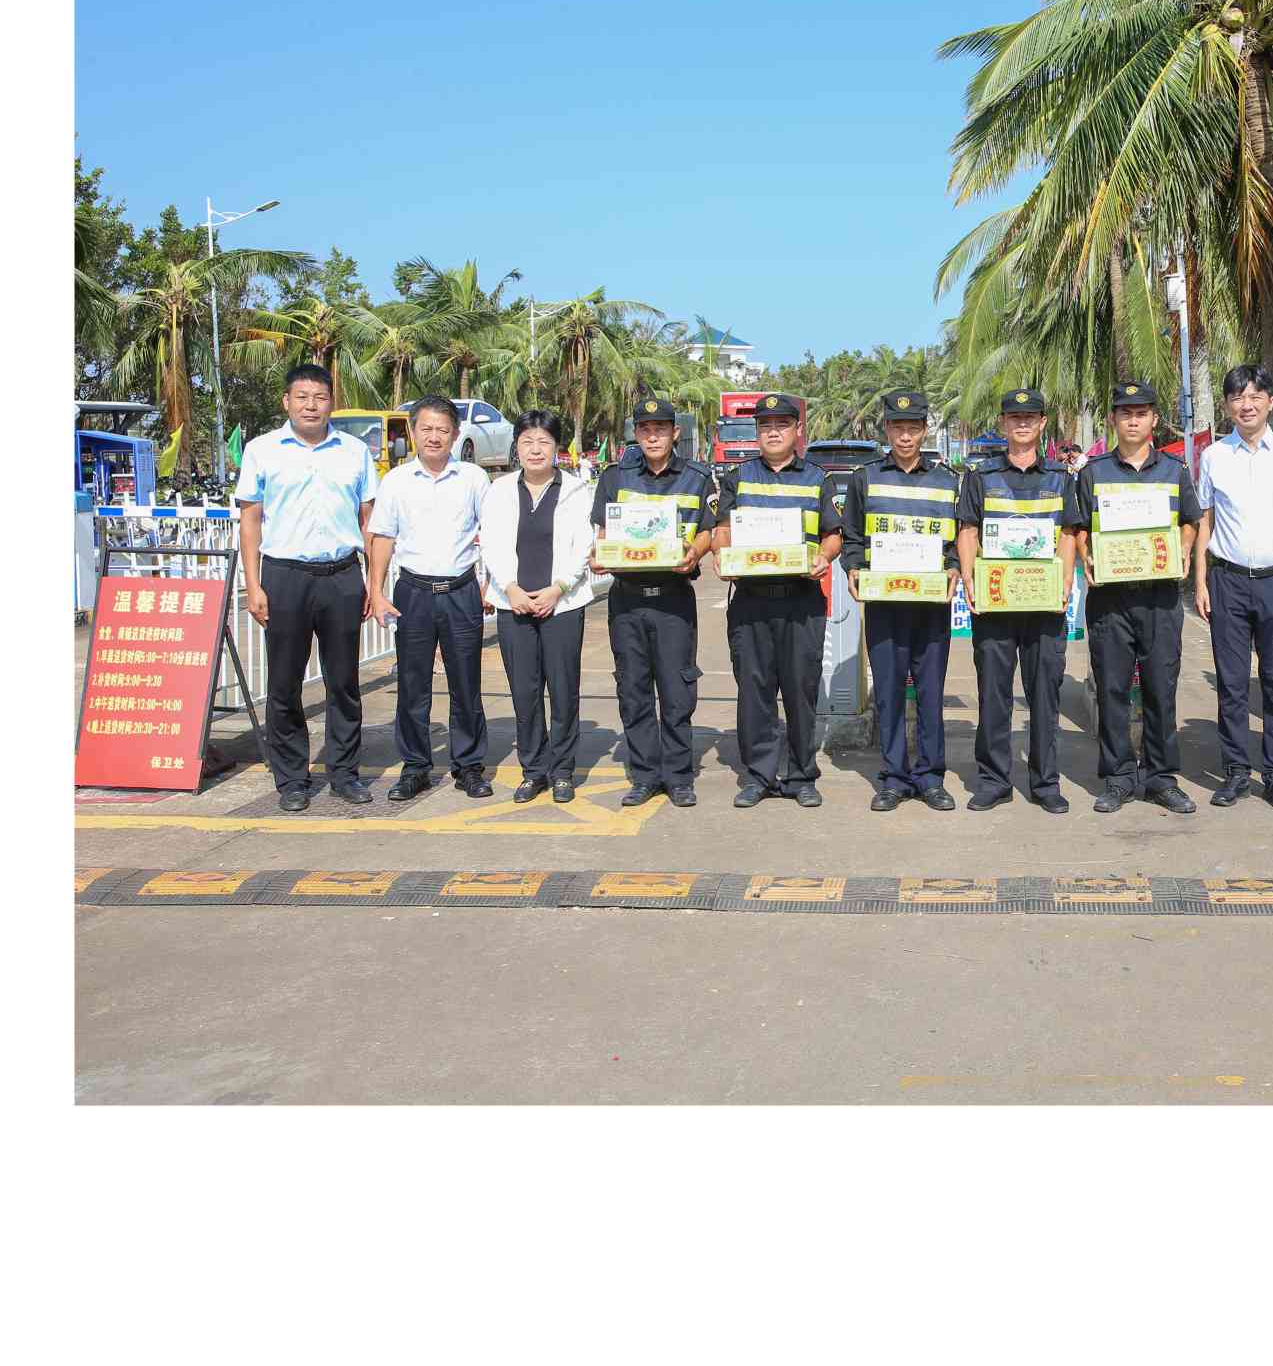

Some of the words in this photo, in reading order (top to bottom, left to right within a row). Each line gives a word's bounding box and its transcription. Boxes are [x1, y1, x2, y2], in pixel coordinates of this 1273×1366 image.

[112, 590, 205, 614] 温馨提醒
[150, 755, 185, 770] 保卫处
